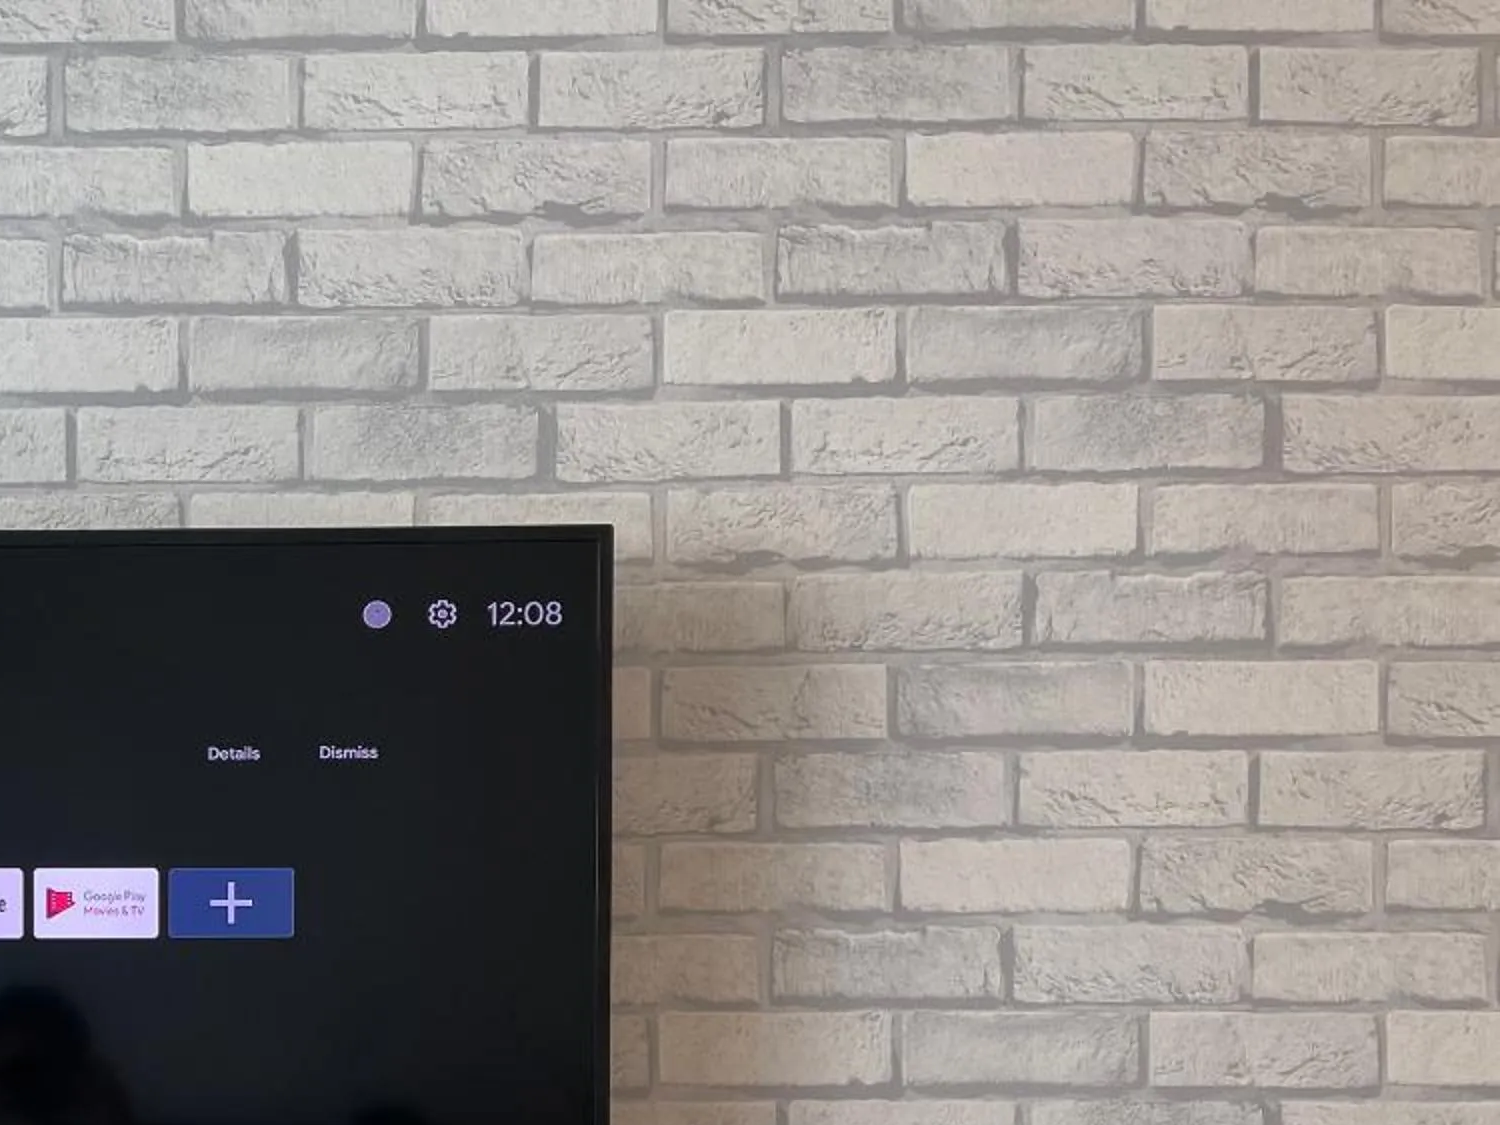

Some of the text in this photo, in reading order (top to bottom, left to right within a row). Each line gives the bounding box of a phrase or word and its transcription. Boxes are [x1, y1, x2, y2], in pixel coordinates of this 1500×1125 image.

[487, 600, 563, 627] 12:08
[207, 745, 261, 762] Details
[318, 744, 380, 760] Dismiss
[83, 889, 146, 905] Google Play
[83, 905, 120, 917] Movies
[131, 905, 146, 917] TV
